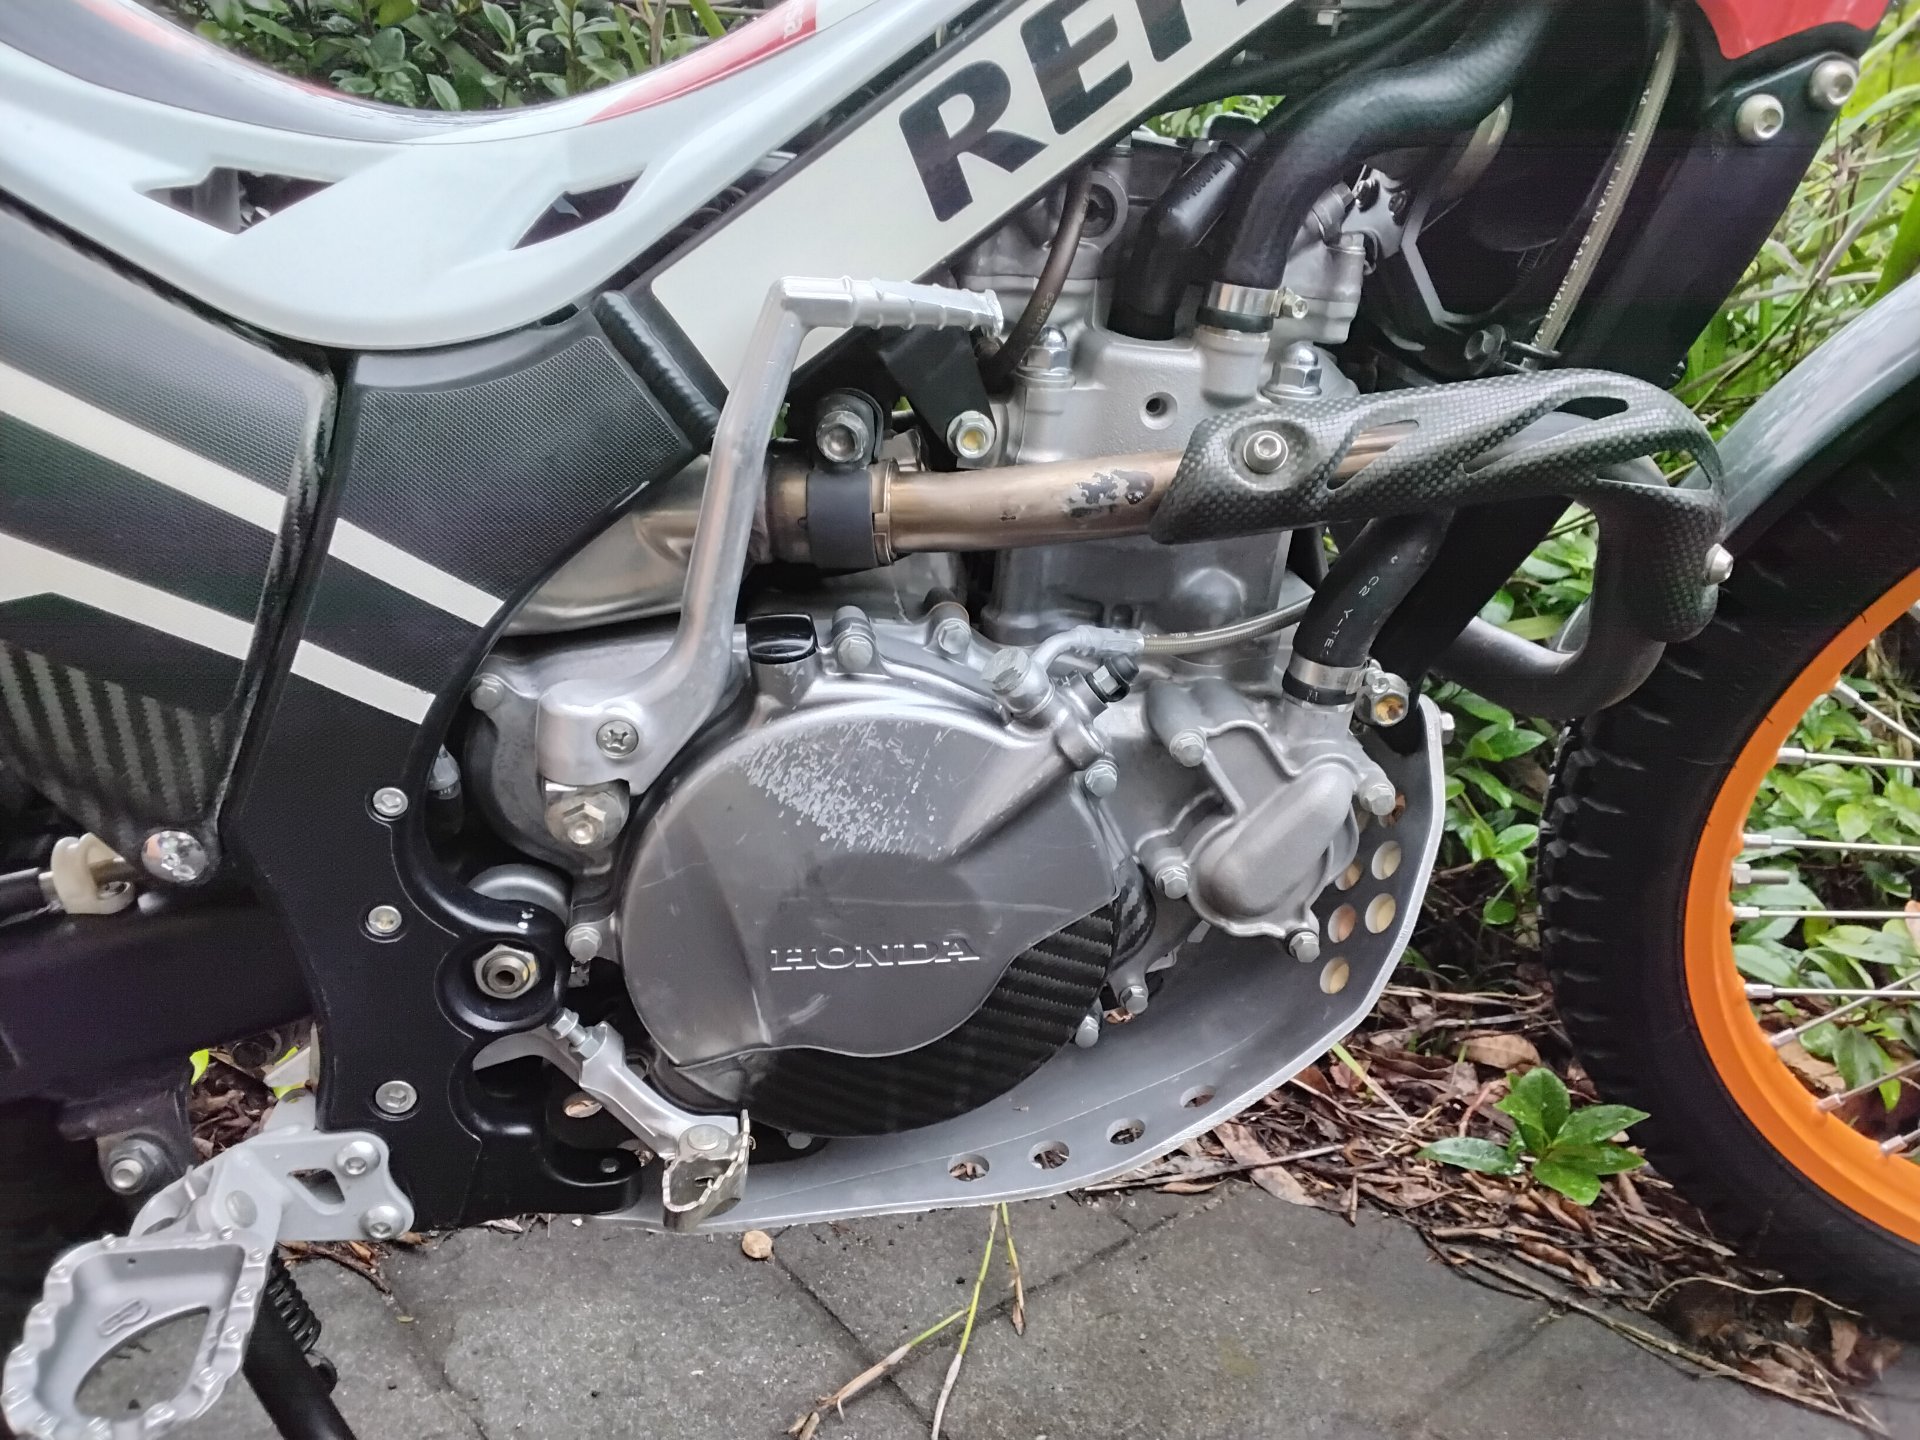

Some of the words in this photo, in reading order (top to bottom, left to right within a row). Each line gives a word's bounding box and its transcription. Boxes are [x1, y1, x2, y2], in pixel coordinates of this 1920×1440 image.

[1358, 575, 1380, 597] C2
[1324, 608, 1354, 655] Y-TE
[770, 937, 981, 971] HONDA
